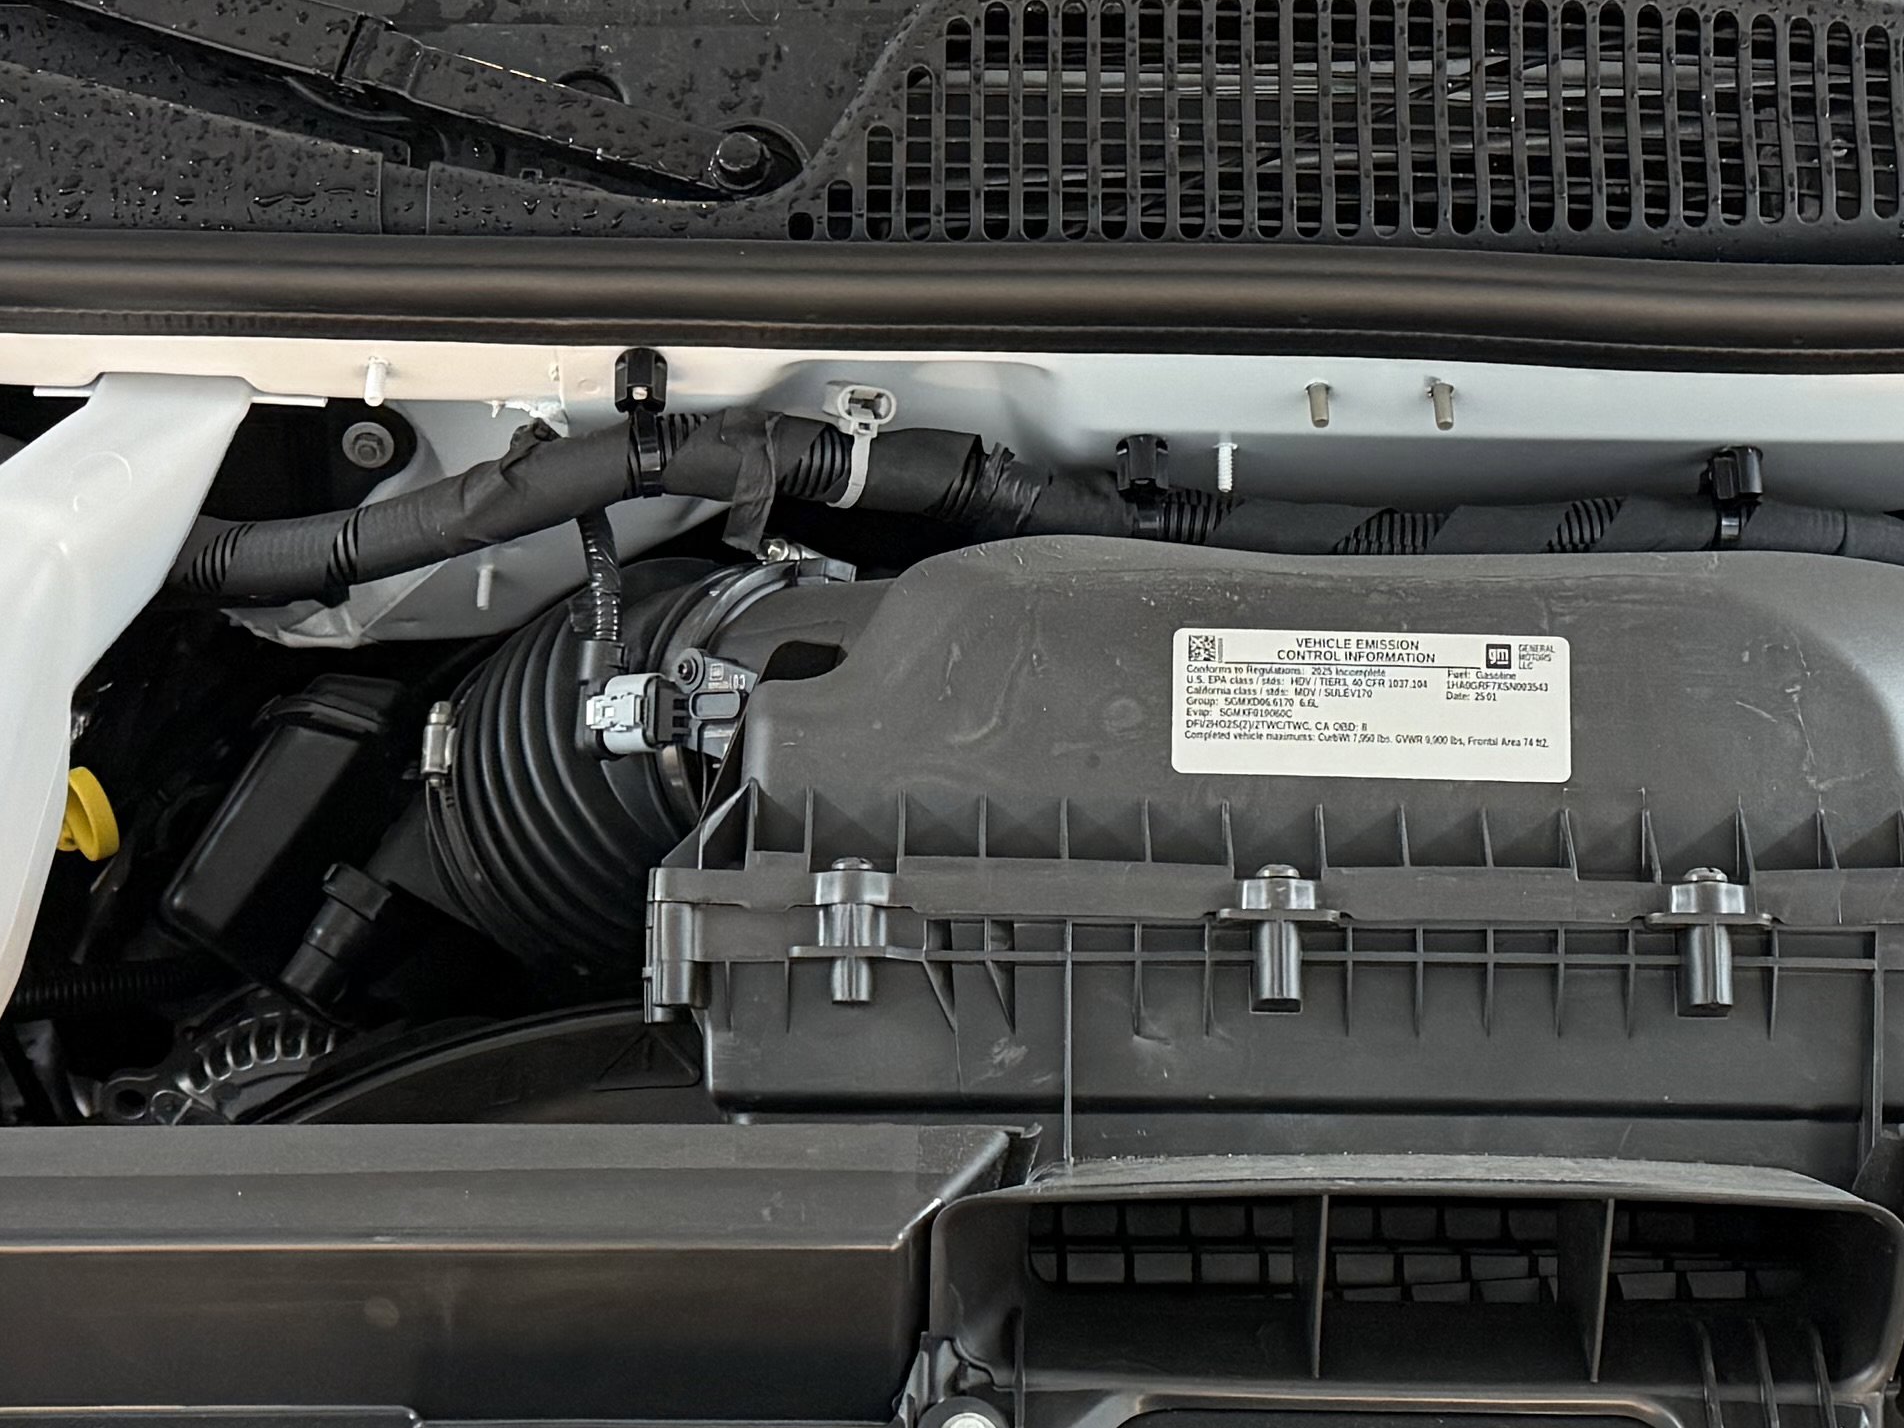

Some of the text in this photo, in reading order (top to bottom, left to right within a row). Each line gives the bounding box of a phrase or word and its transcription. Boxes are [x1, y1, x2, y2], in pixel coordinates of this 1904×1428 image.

[1296, 638, 1419, 651] VEHICLE EMISSION
[1518, 644, 1555, 653] GENERAL
[1277, 650, 1435, 663] CONTROL INFORMATION
[1488, 649, 1509, 664] gm
[1186, 664, 1232, 673] Conforms
[1234, 666, 1243, 674] to
[1311, 667, 1332, 675] 2025
[1518, 661, 1533, 670] LLC
[1208, 676, 1227, 684] EPA
[1230, 676, 1254, 685] class
[1291, 677, 1311, 686] HDV
[1365, 679, 1385, 687] CFR
[1234, 687, 1257, 695] class
[1446, 692, 1470, 701] Date:
[1186, 697, 1218, 707] Group:
[1315, 722, 1329, 730] CA
[1395, 735, 1423, 744] GVWR
